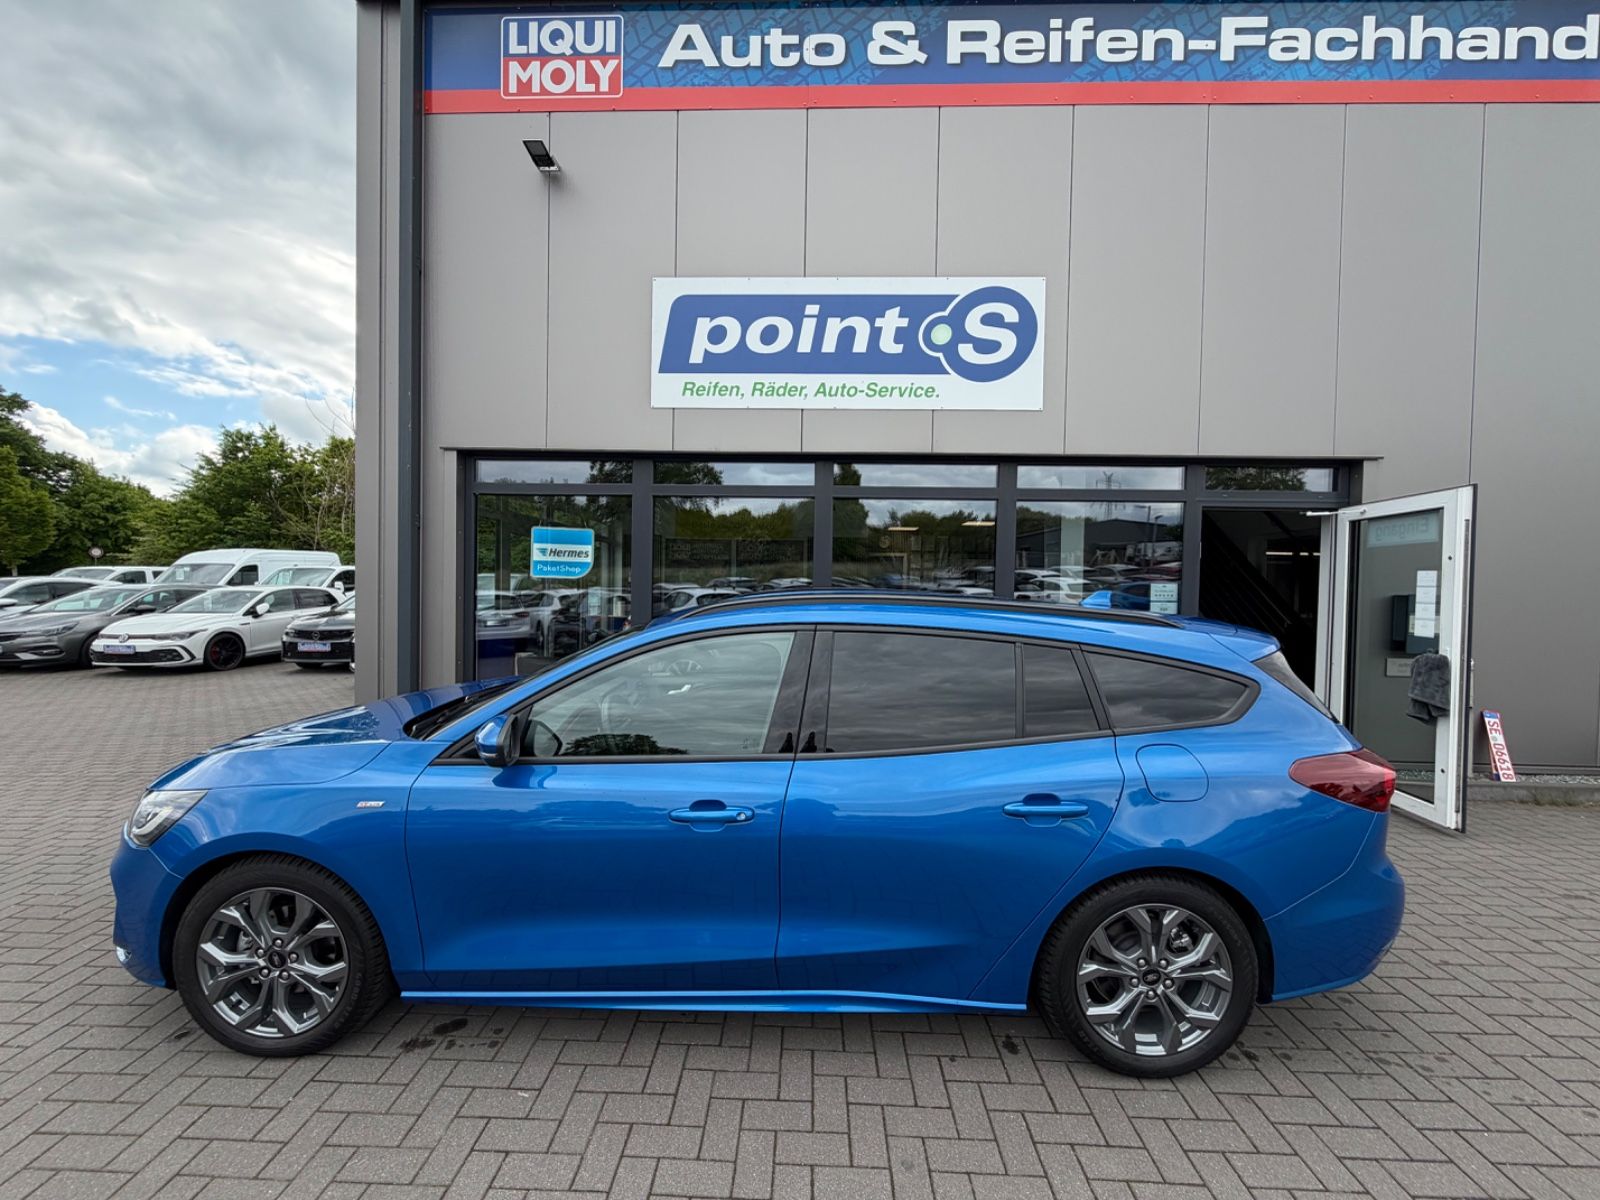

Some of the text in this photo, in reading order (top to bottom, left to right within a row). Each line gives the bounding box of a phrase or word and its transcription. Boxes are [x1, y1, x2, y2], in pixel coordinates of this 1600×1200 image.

[509, 20, 616, 56] LIQUI
[658, 24, 846, 68] Auto
[867, 20, 928, 64] &
[508, 59, 619, 93] MOLY
[688, 302, 1020, 365] point S
[681, 381, 940, 399] Reifen, Räder, Auto-Service.
[537, 564, 581, 573] PaketShop
[548, 547, 590, 558] Hermes
